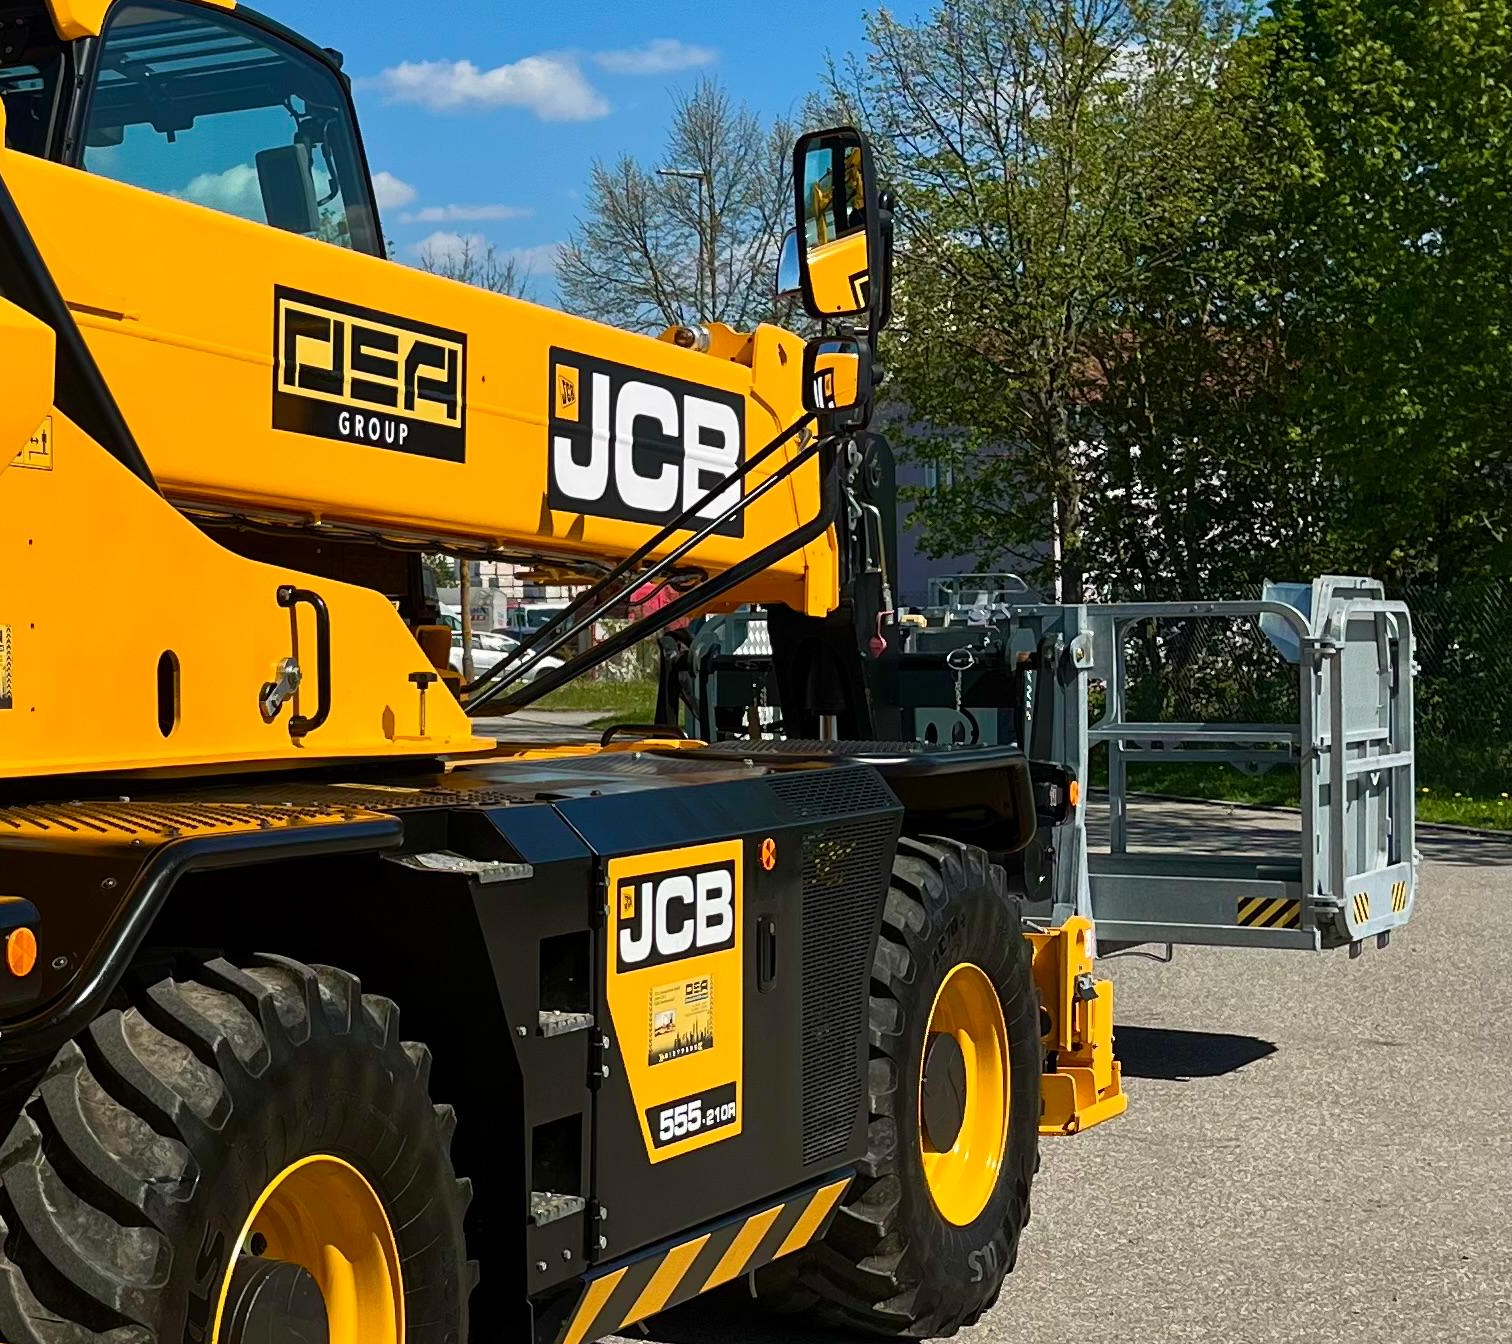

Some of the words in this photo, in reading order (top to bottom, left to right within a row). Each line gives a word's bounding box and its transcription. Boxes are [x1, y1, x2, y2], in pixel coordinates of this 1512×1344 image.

[338, 411, 409, 445] GROUP
[553, 372, 742, 521] JCB
[619, 869, 733, 963] JCB
